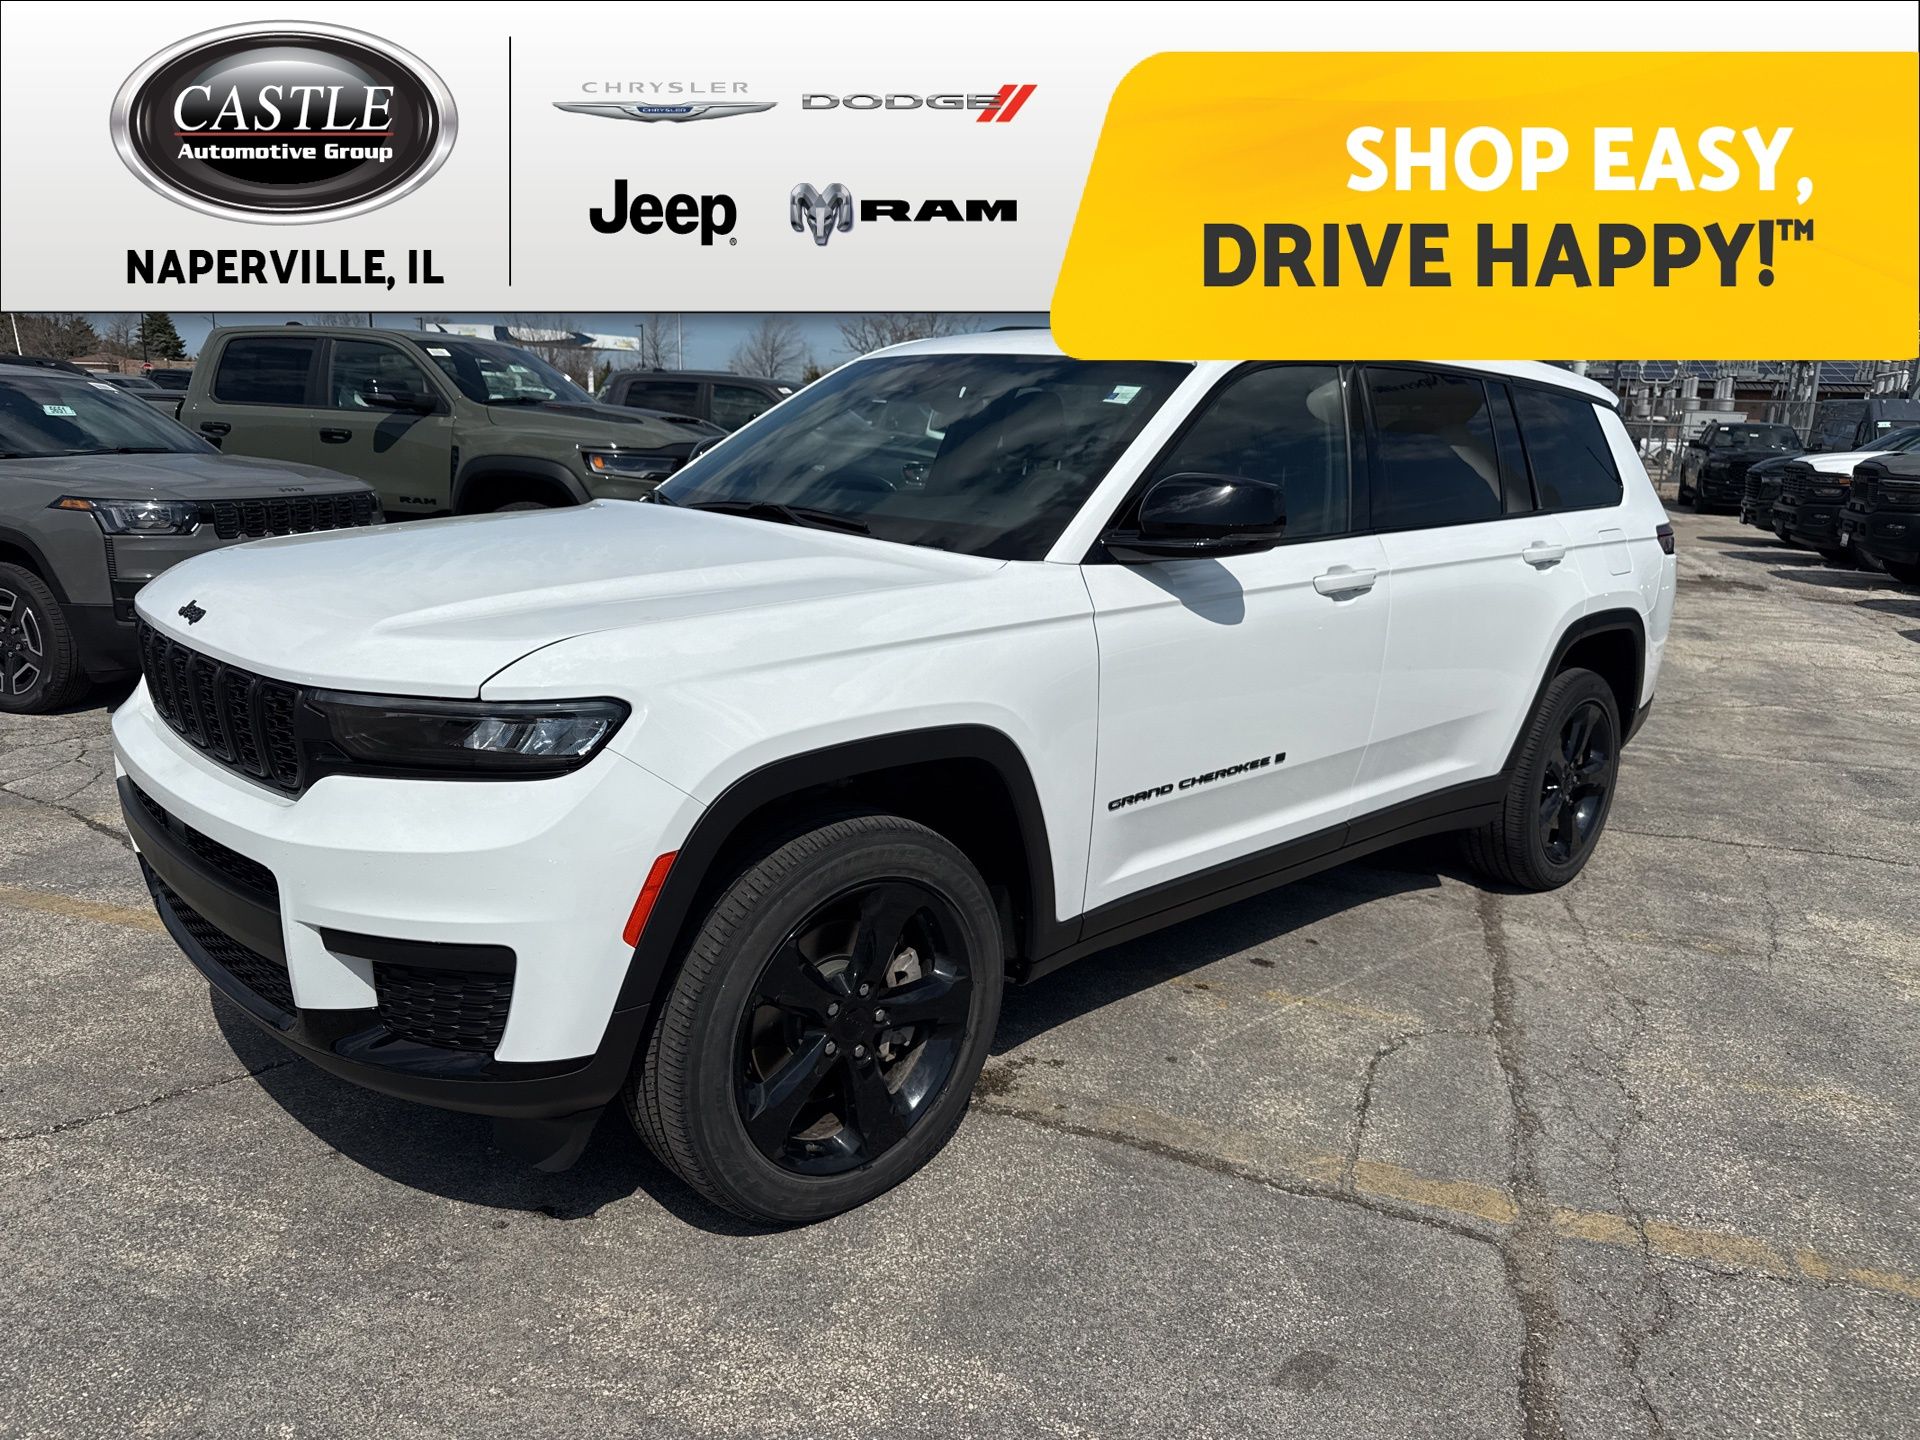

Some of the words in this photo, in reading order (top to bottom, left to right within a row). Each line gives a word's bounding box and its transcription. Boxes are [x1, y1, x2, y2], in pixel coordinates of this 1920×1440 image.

[399, 495, 437, 506] RAM
[1107, 783, 1174, 811] GRAND
[1178, 755, 1271, 791] CHEROKEE
